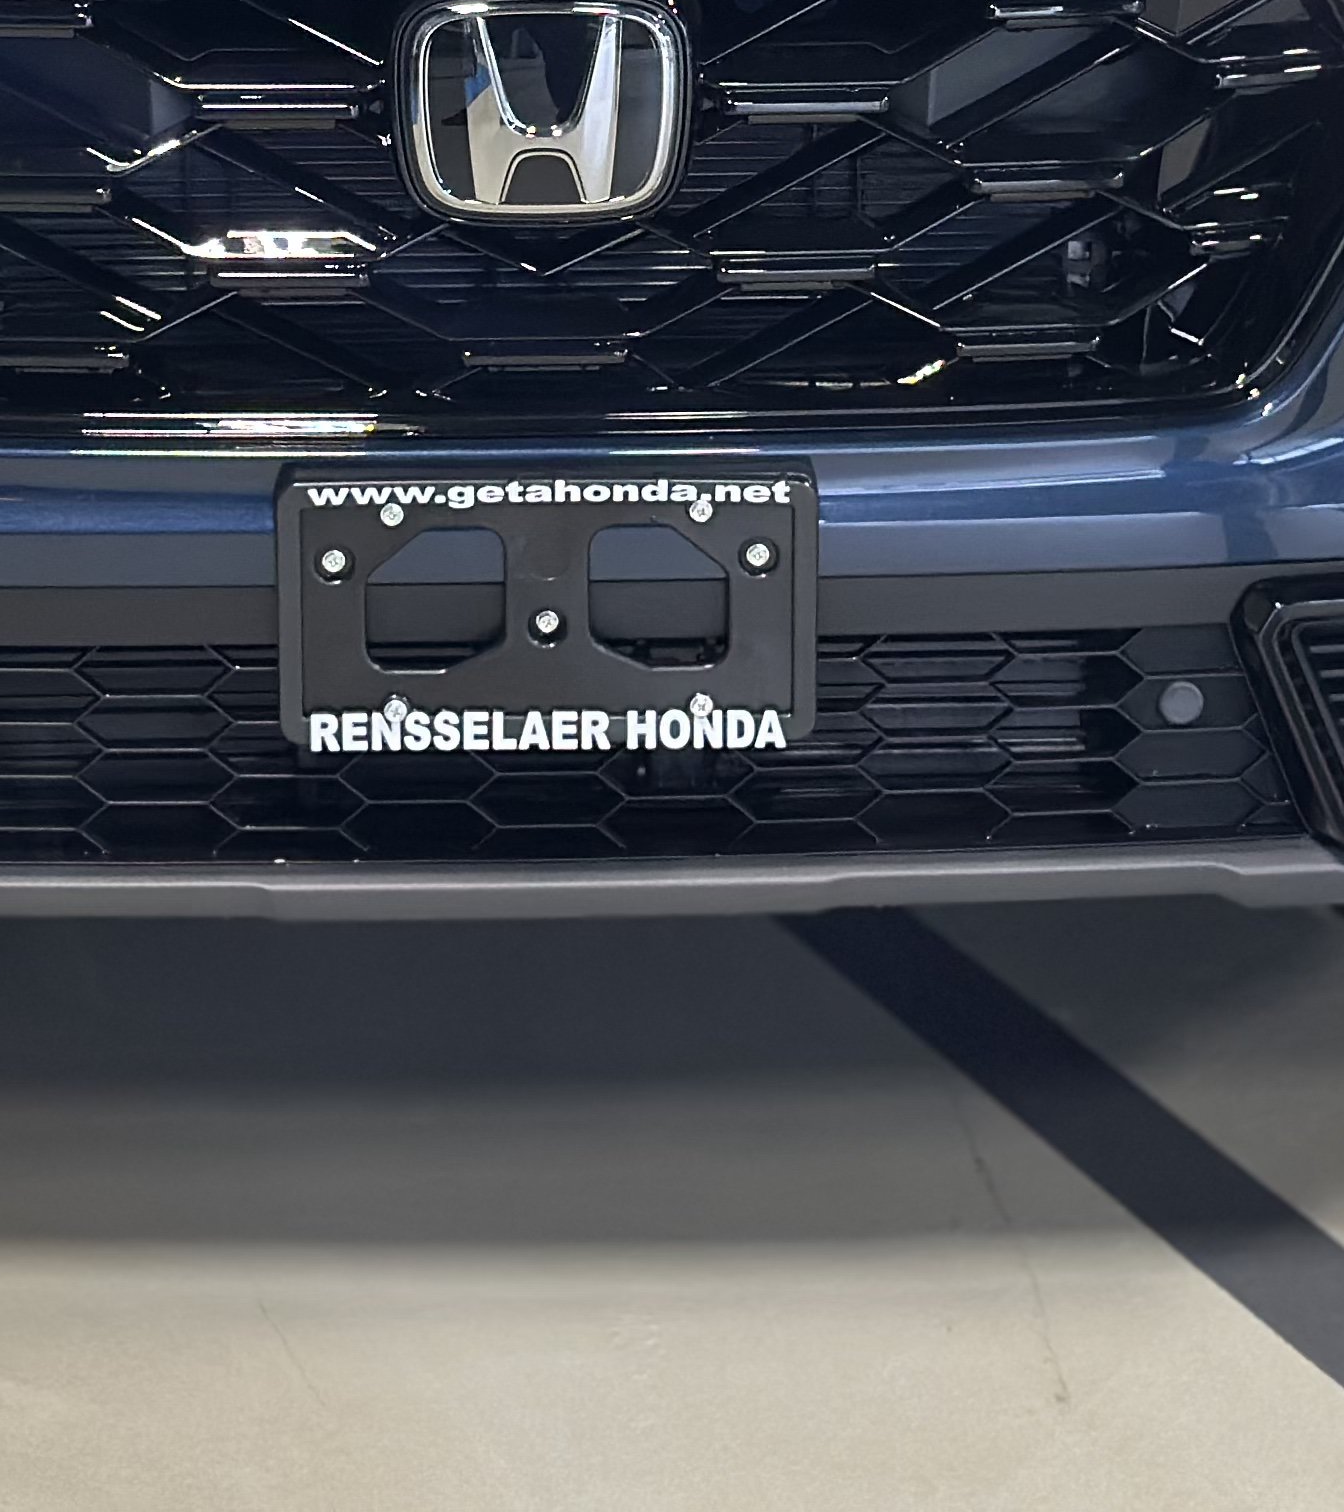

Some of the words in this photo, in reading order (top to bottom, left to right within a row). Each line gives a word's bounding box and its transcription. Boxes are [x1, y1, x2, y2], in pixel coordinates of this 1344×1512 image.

[308, 480, 792, 509] www.getahonda.net
[309, 710, 611, 752] RENSSELAER
[627, 709, 787, 750] HONDA
